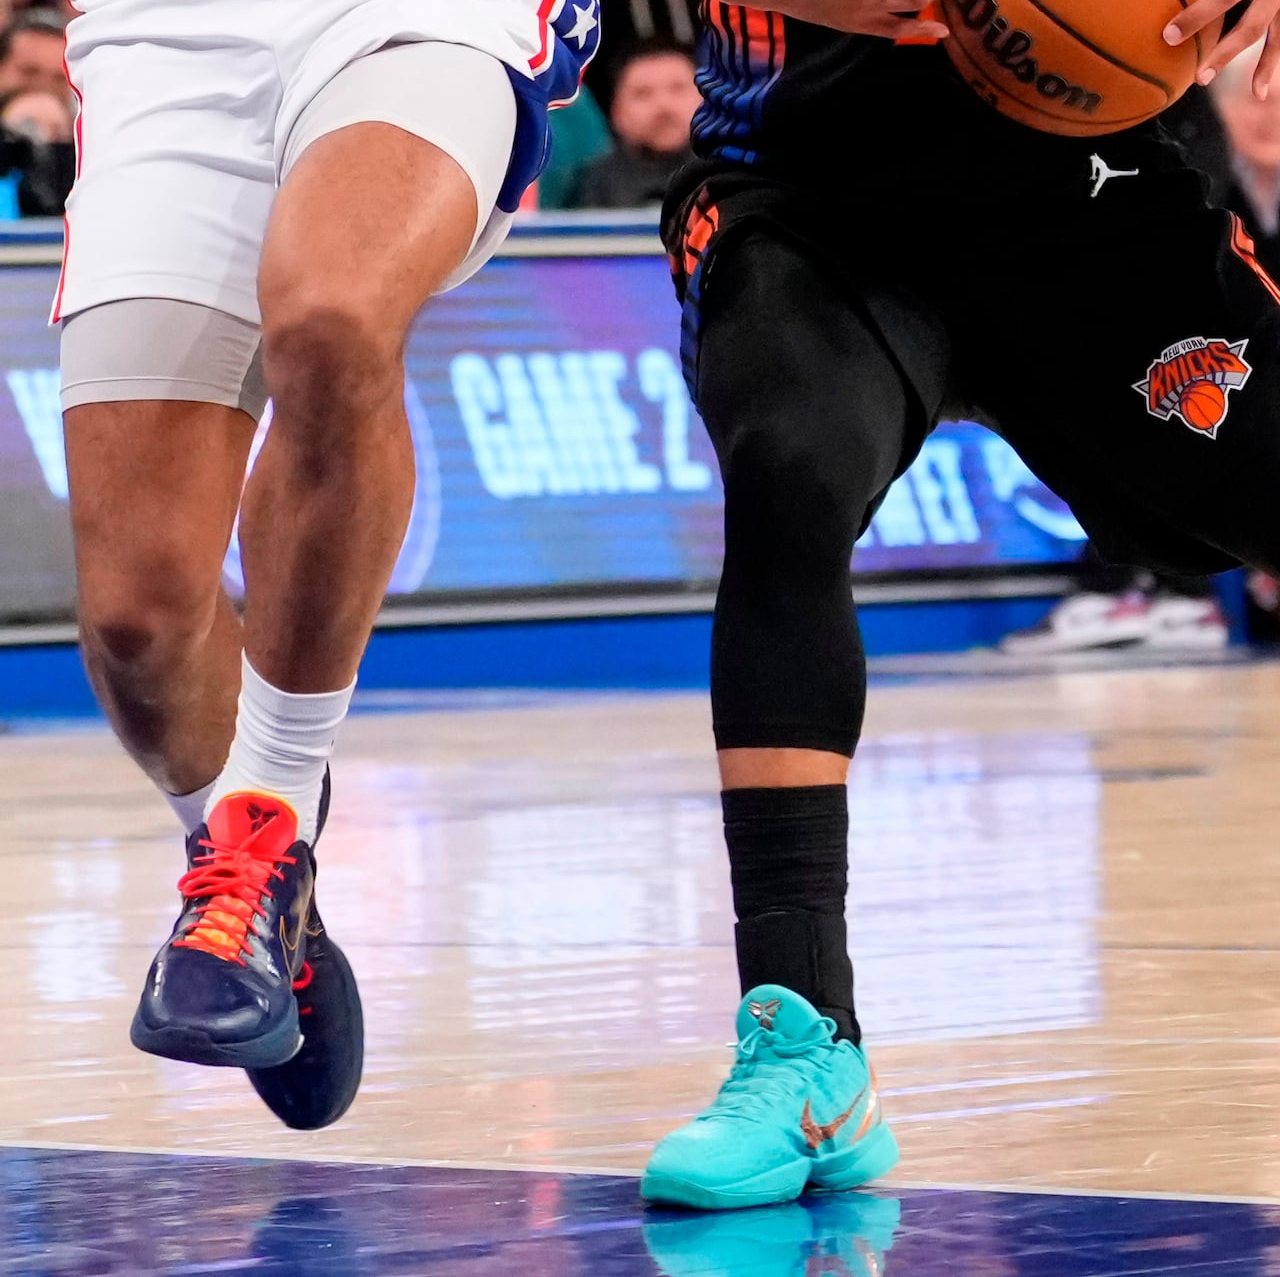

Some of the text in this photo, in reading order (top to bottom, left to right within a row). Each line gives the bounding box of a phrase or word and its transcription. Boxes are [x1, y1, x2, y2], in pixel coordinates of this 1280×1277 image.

[1149, 341, 1249, 412] KNICKS
[1162, 338, 1206, 363] NEW YORK
[450, 346, 713, 499] GAME 2
